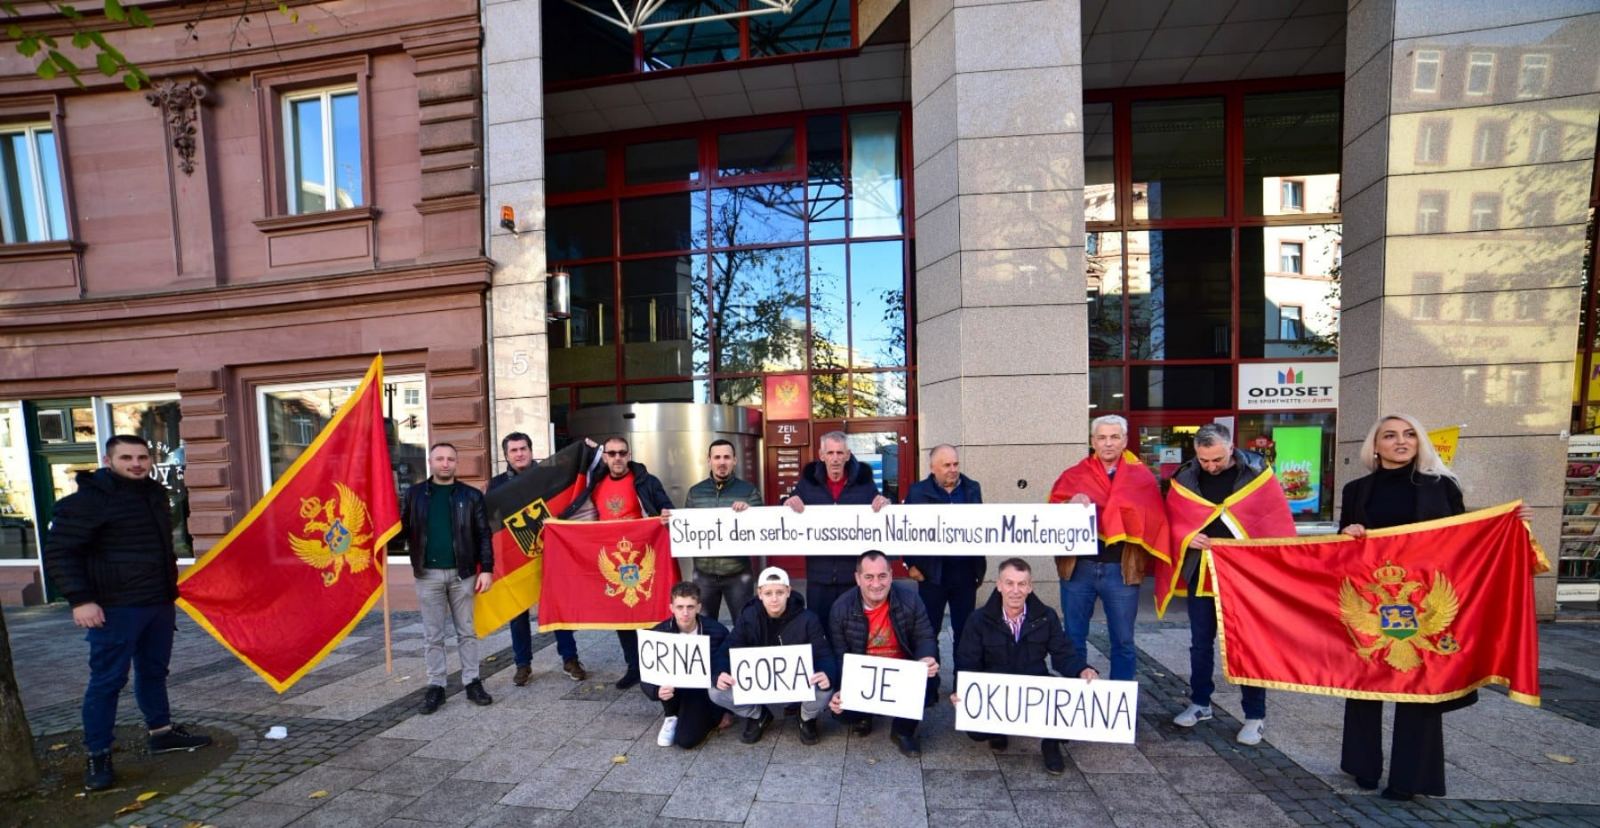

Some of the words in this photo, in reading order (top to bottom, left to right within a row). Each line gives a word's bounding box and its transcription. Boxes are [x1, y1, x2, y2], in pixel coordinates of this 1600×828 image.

[512, 350, 528, 375] 5
[1248, 386, 1332, 397] ODDSET
[777, 425, 798, 433] ZEIL
[783, 434, 792, 444] 5
[1280, 459, 1312, 471] Wolt
[672, 517, 723, 549] Stoppt
[729, 518, 756, 541] den
[760, 514, 882, 542] serbo-russischen
[885, 514, 983, 543] Nationalismus
[985, 525, 998, 543] in
[1001, 514, 1095, 551] Montenegro!
[640, 639, 707, 676] CRNA
[736, 656, 811, 691] GORA
[860, 665, 899, 703] JE
[964, 682, 1132, 730] OKUPIRANA
